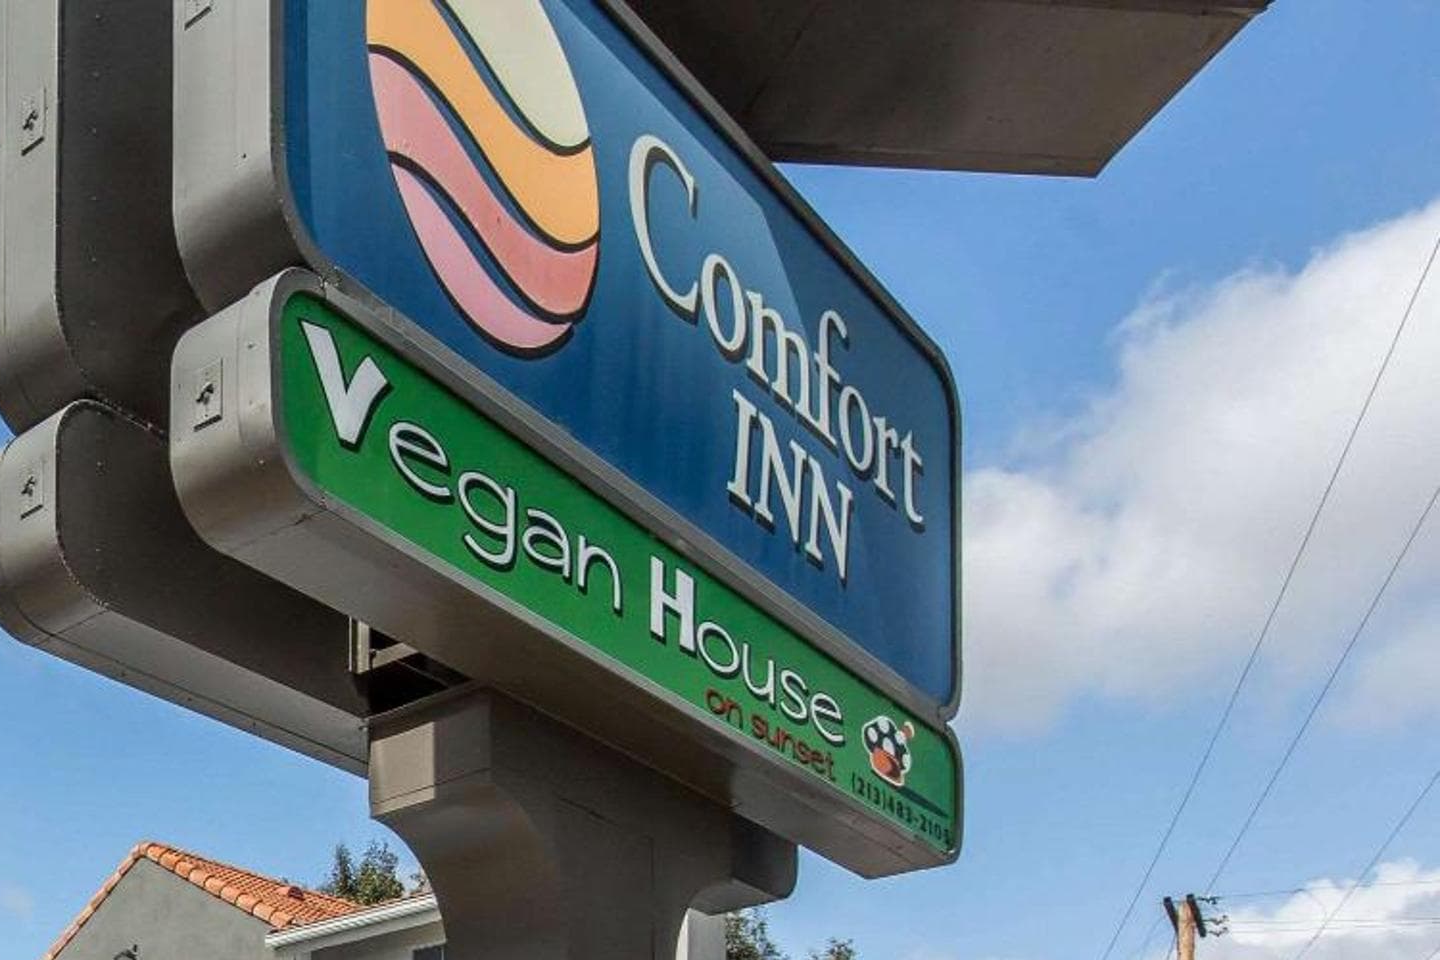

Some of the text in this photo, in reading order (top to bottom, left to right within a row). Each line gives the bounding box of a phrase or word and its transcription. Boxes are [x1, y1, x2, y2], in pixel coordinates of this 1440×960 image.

[628, 134, 925, 534] Comfort
[300, 319, 845, 745] Vegan House
[726, 388, 853, 582] INN
[705, 688, 836, 782] on sunset
